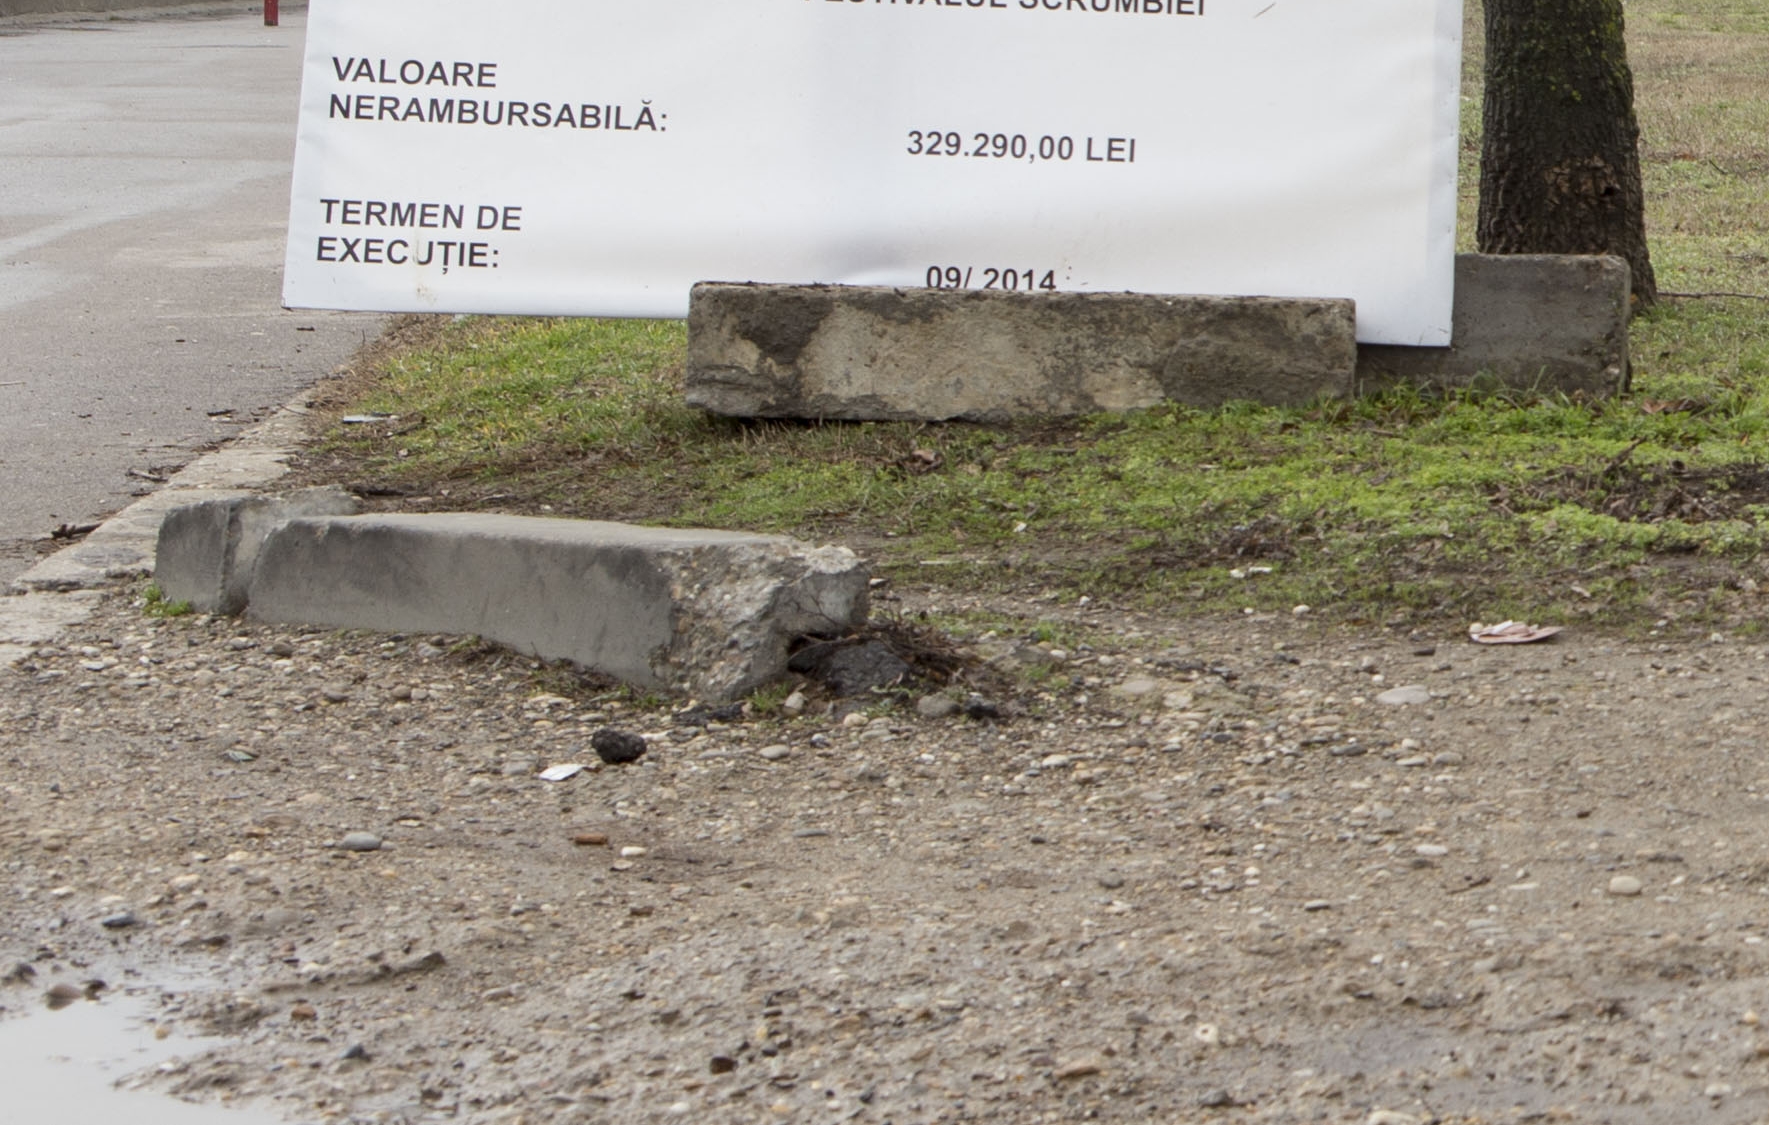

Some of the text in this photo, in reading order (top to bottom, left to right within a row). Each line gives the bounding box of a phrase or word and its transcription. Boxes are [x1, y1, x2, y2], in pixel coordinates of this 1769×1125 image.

[331, 56, 497, 88] VALOARE
[329, 94, 667, 132] NERAMBURSABILĂ:
[907, 130, 1136, 164] 329.290,00 LEI
[319, 198, 522, 231] TERMEN DE
[316, 236, 499, 275] EXECUȚIE:
[926, 266, 1057, 291] 09/ 2014
